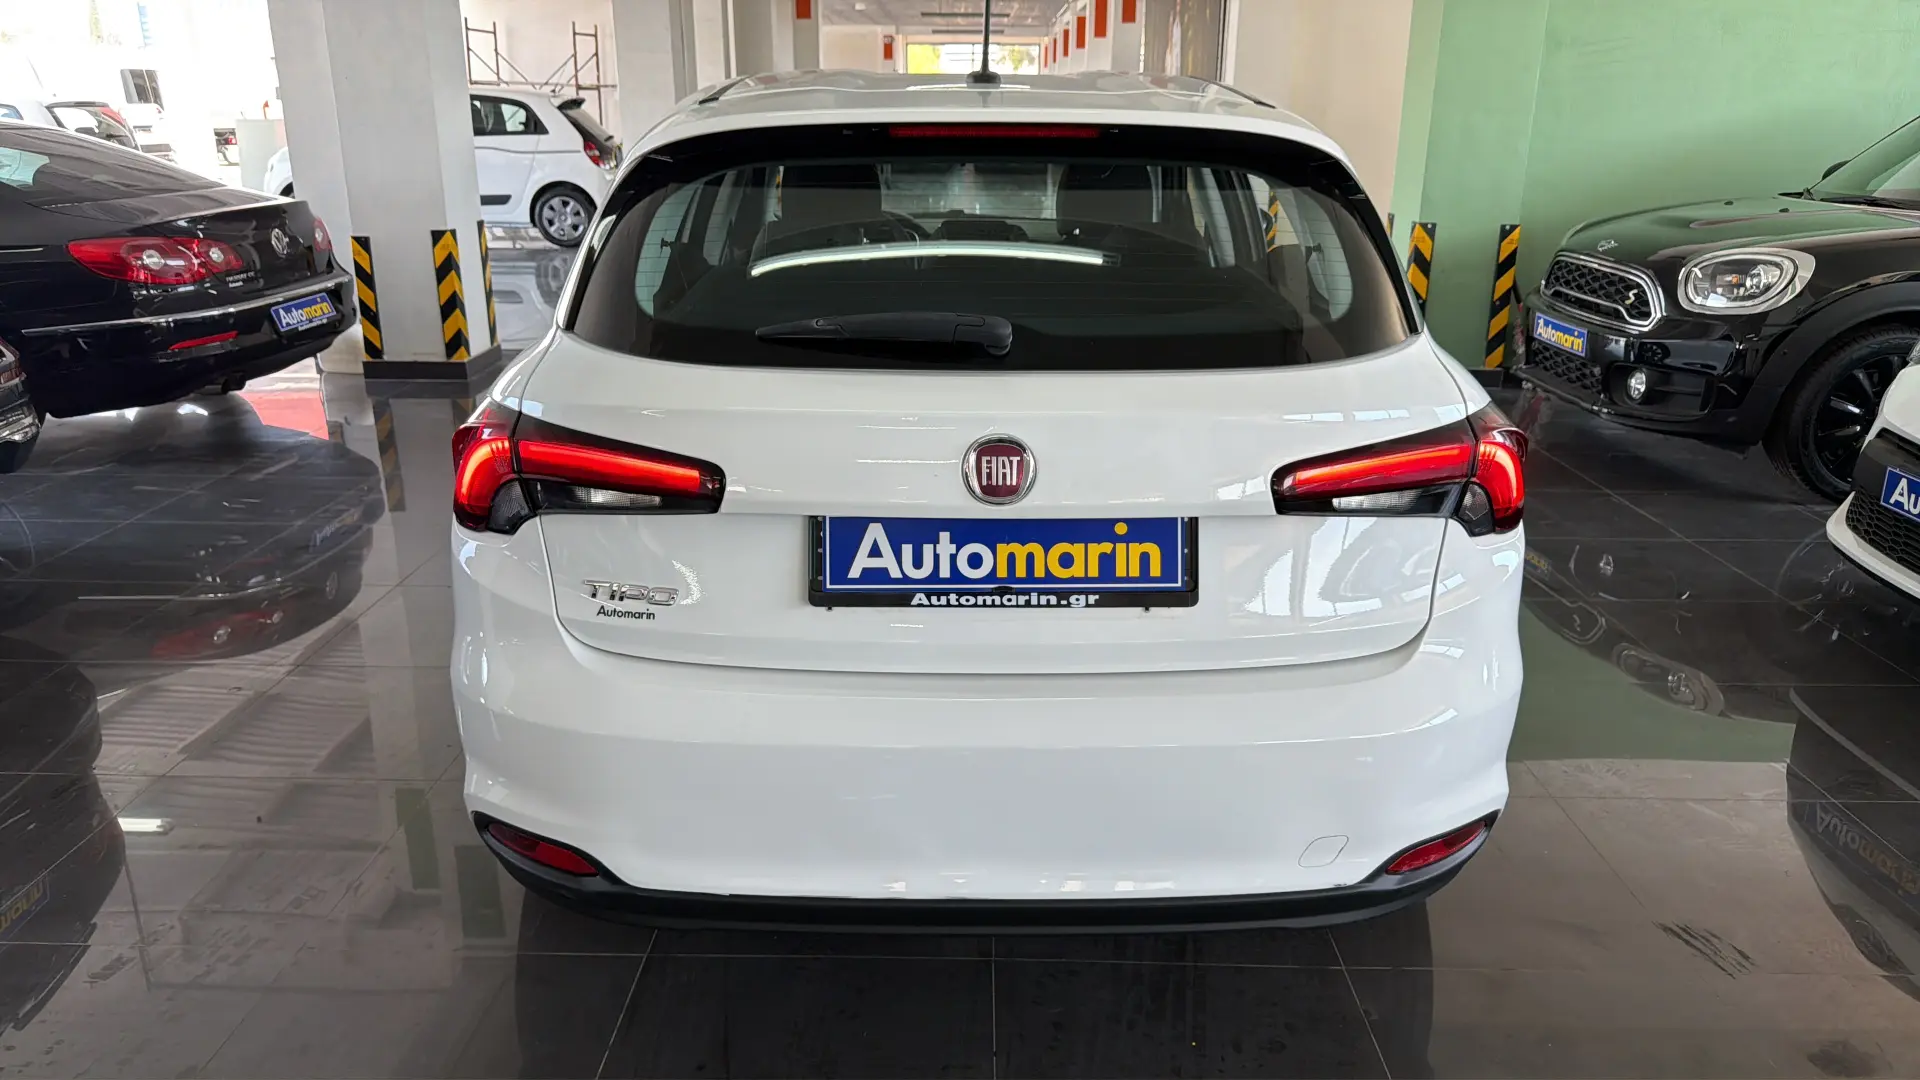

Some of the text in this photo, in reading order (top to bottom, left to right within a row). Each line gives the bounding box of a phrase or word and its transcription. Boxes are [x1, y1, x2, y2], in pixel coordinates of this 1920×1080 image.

[278, 297, 333, 328] Automarin
[1537, 318, 1584, 353] Automarin
[981, 456, 1021, 486] FIAT
[847, 521, 1161, 579] Automarin
[583, 579, 680, 606] TIPO
[910, 592, 1100, 608] Automarin.gr
[596, 605, 656, 620] Automarin
